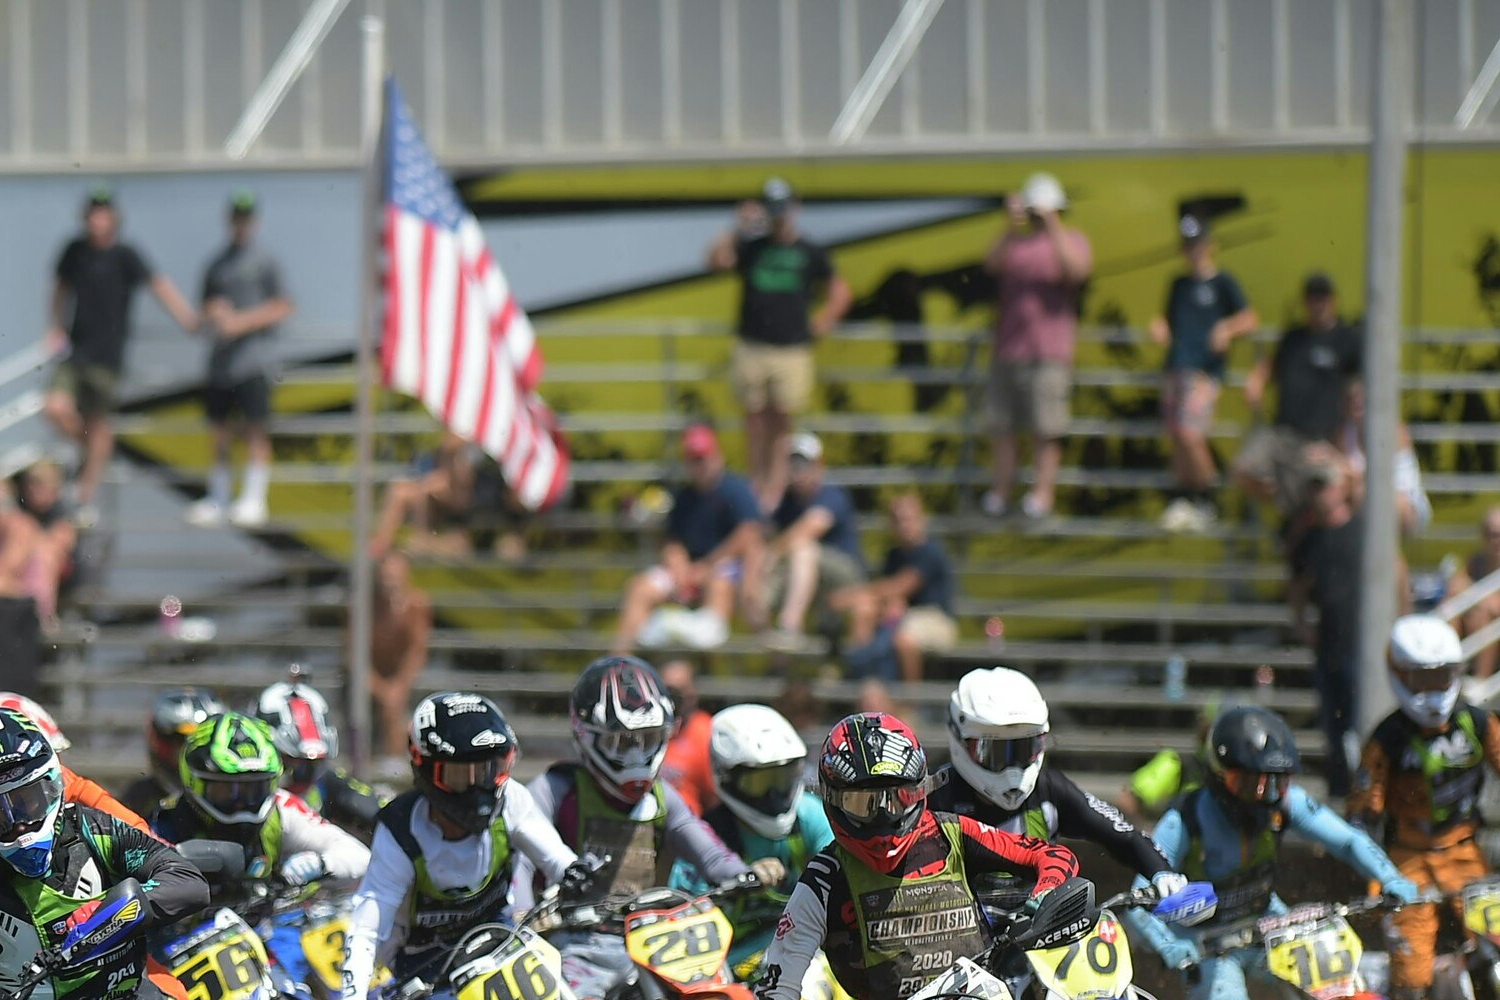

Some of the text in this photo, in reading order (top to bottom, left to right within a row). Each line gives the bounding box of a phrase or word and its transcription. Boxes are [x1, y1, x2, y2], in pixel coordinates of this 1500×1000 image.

[905, 884, 947, 897] MONSTER
[1171, 897, 1206, 921] UFO
[90, 918, 125, 945] CYCRA
[643, 921, 721, 967] 28
[1033, 916, 1091, 949] ACERBIS
[911, 951, 953, 971] 2020
[1048, 935, 1118, 981] 70
[901, 978, 922, 996] 39
